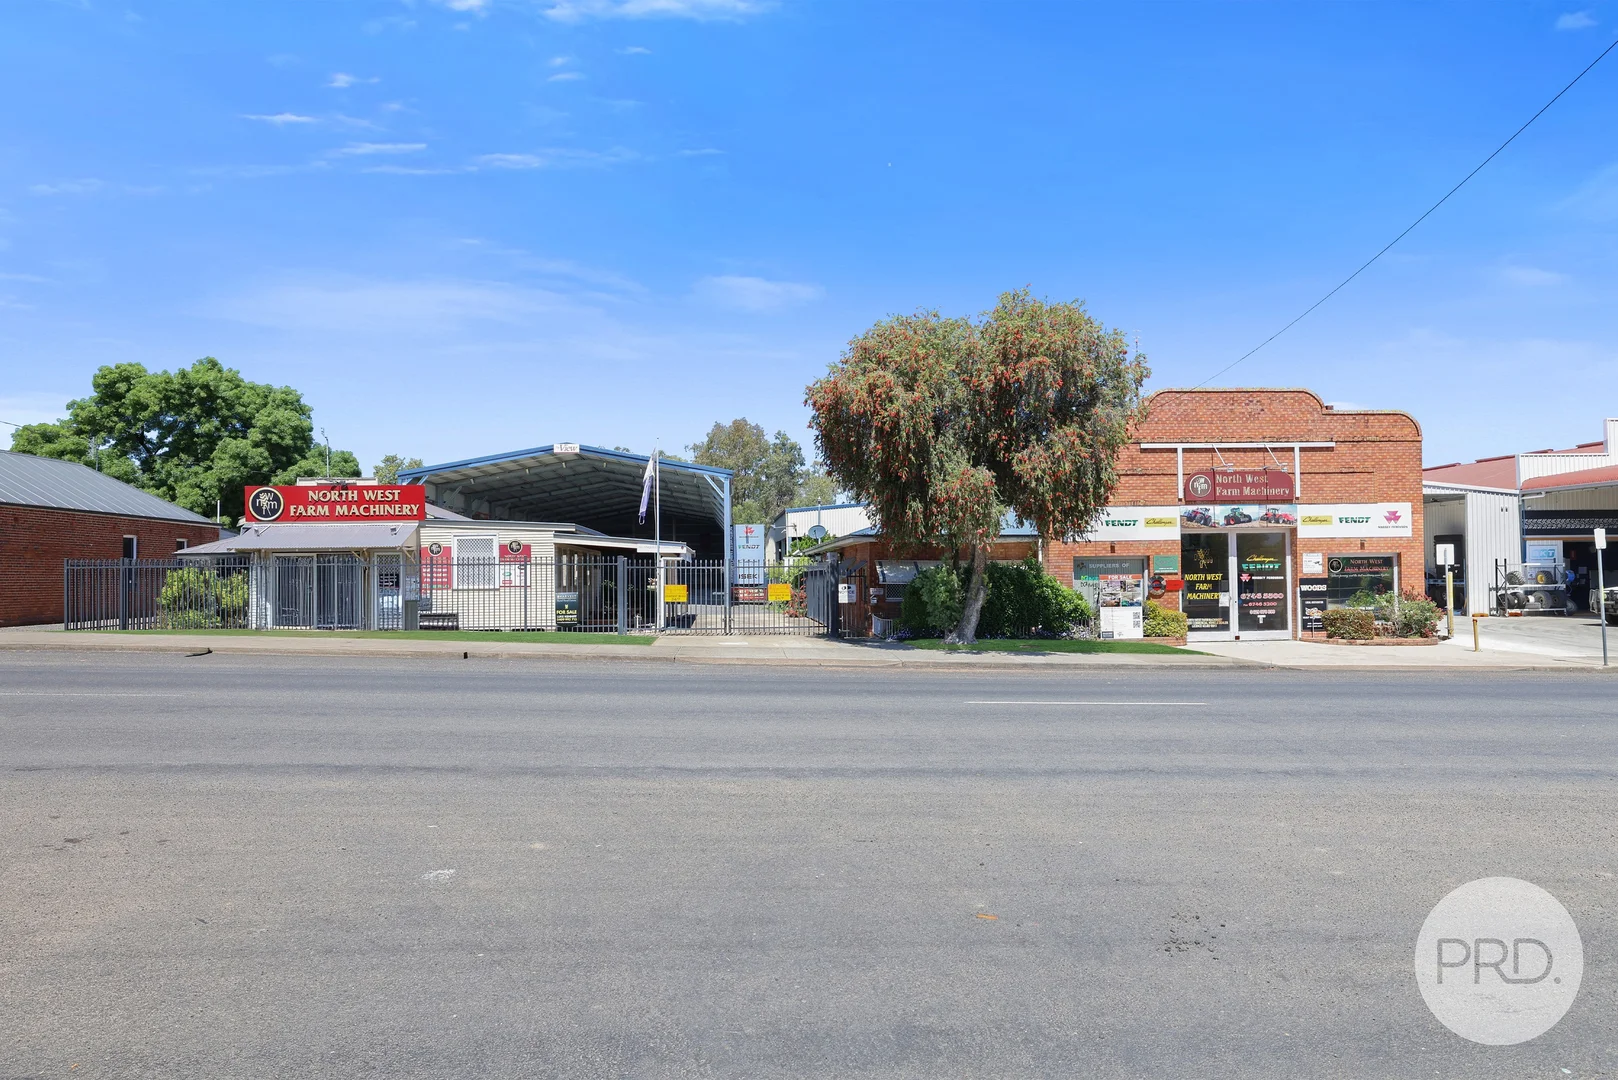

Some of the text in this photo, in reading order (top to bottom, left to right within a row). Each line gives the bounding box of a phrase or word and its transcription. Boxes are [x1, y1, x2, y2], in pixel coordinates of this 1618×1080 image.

[1216, 474, 1269, 483] North West
[308, 490, 401, 502] NORTH WEST
[1216, 486, 1290, 497] Farm Machinery
[290, 504, 420, 517] FARM MACHINERY
[1104, 519, 1139, 527] FENDT
[1338, 516, 1371, 524] FENDT
[1184, 573, 1206, 581] NORTH
